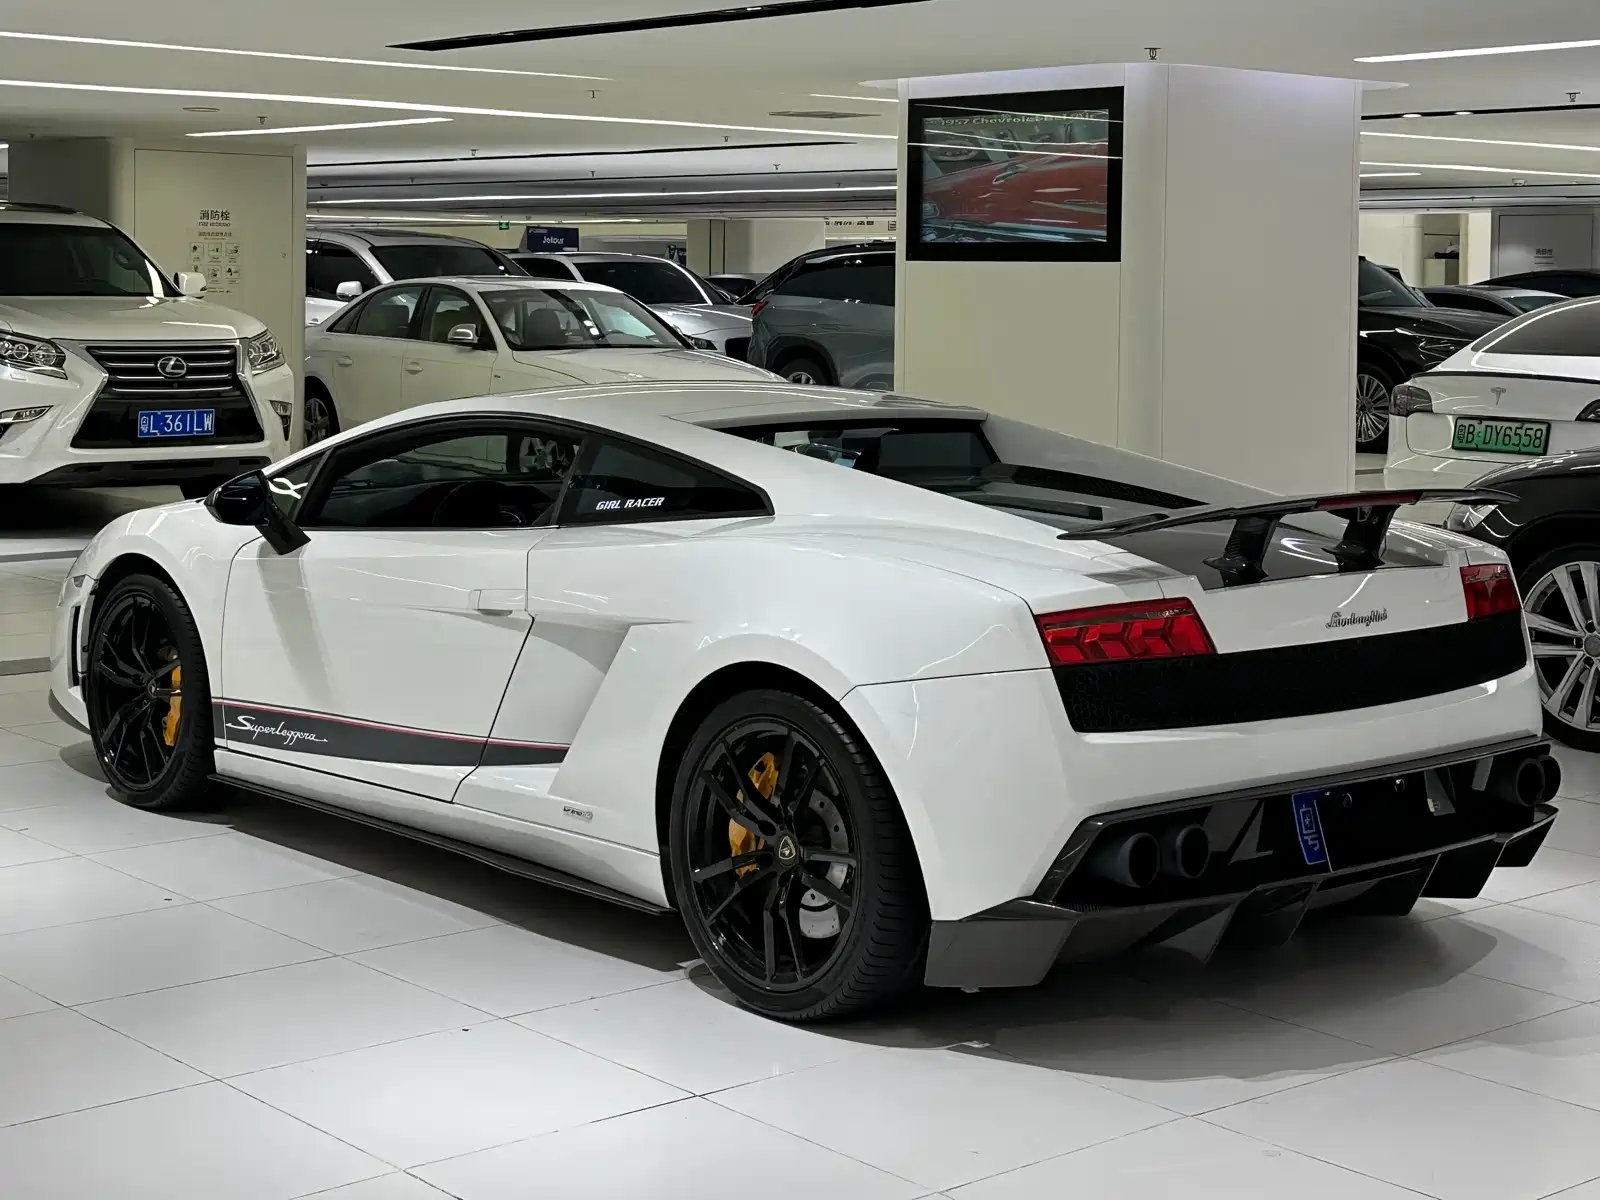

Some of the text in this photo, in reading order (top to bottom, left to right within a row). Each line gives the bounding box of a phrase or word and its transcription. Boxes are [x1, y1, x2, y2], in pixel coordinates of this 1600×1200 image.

[199, 209, 231, 221] 消防栓
[595, 496, 665, 511] GIRL RACER
[225, 715, 328, 746] Superleggera
